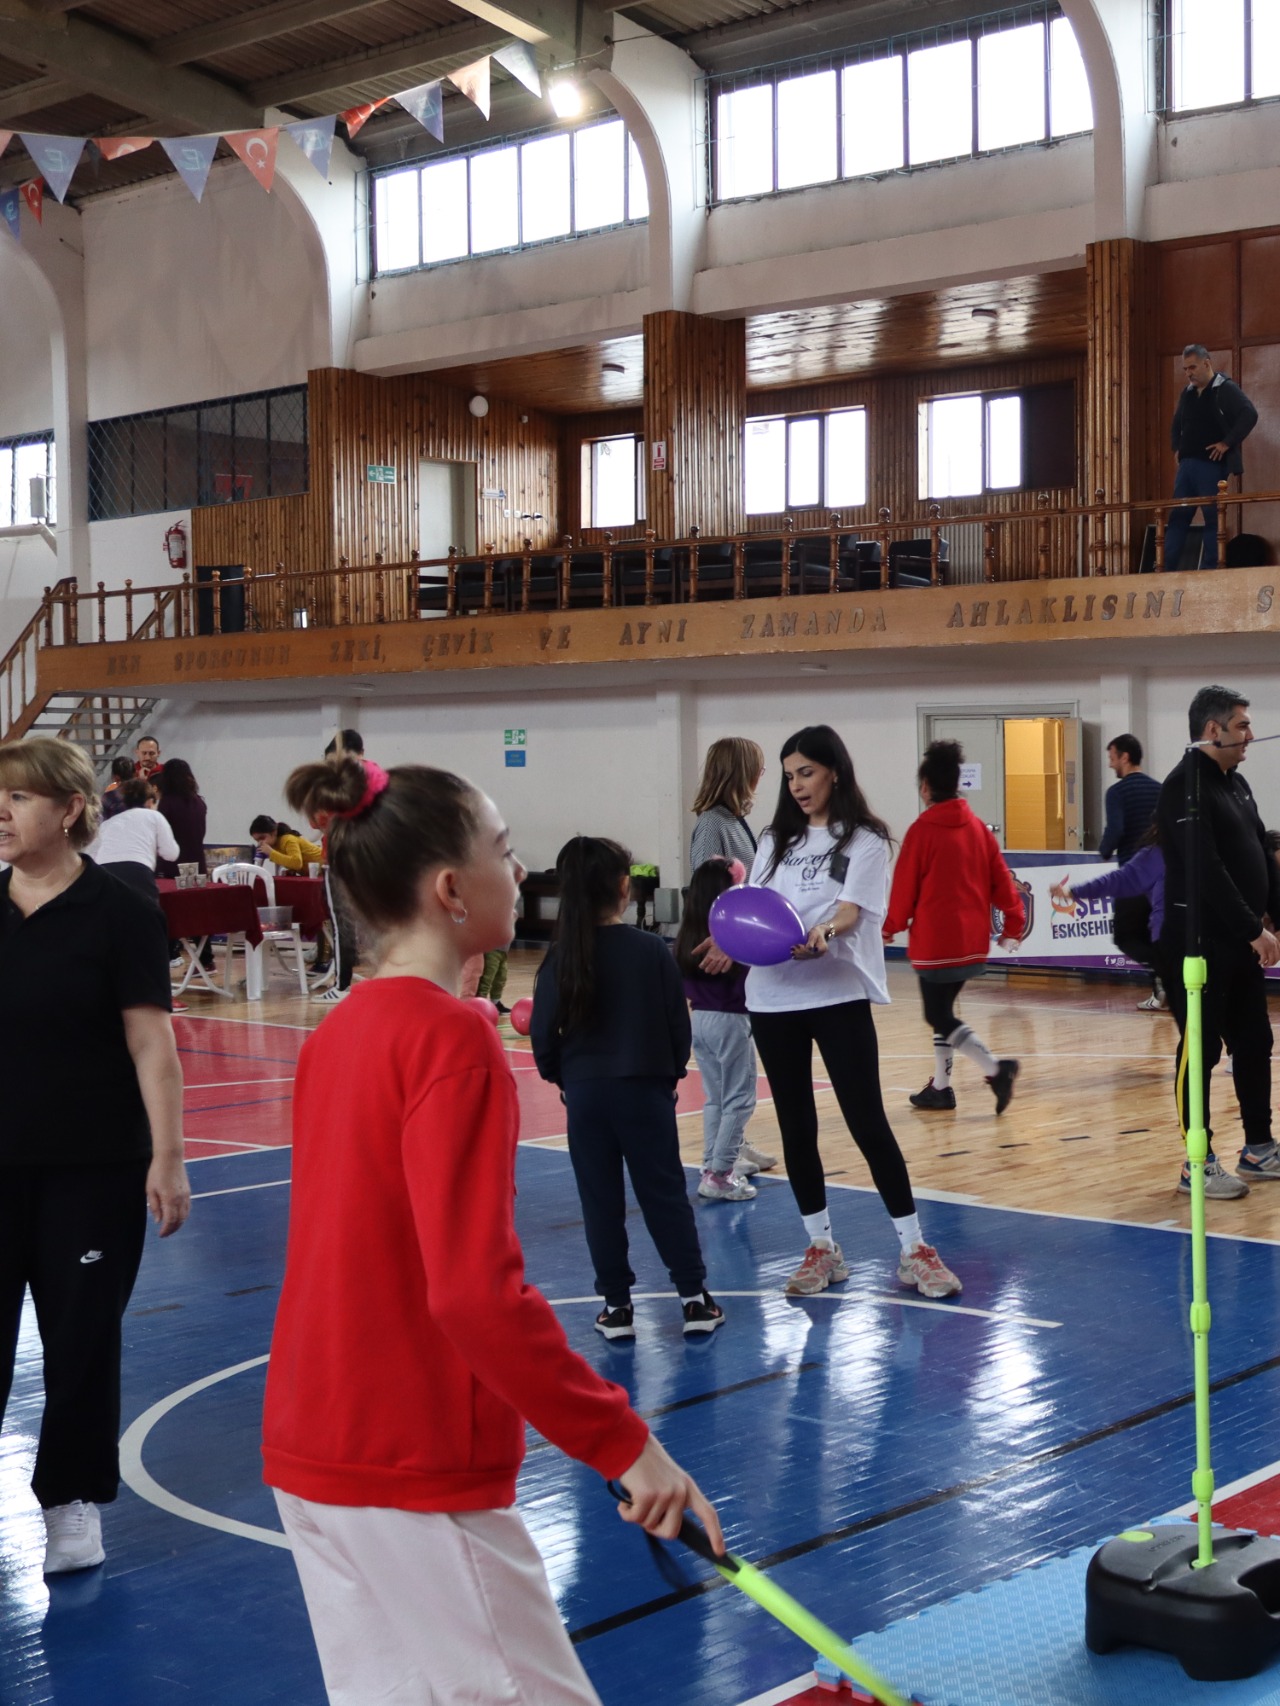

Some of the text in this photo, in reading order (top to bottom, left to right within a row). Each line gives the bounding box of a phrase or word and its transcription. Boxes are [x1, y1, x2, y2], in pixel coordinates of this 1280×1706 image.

[422, 627, 494, 662] ÇEVİK
[539, 625, 572, 651] VE
[619, 618, 688, 646] AYNI
[740, 606, 888, 640] ZAMANDA
[946, 589, 1185, 628] AHLAKLISINI
